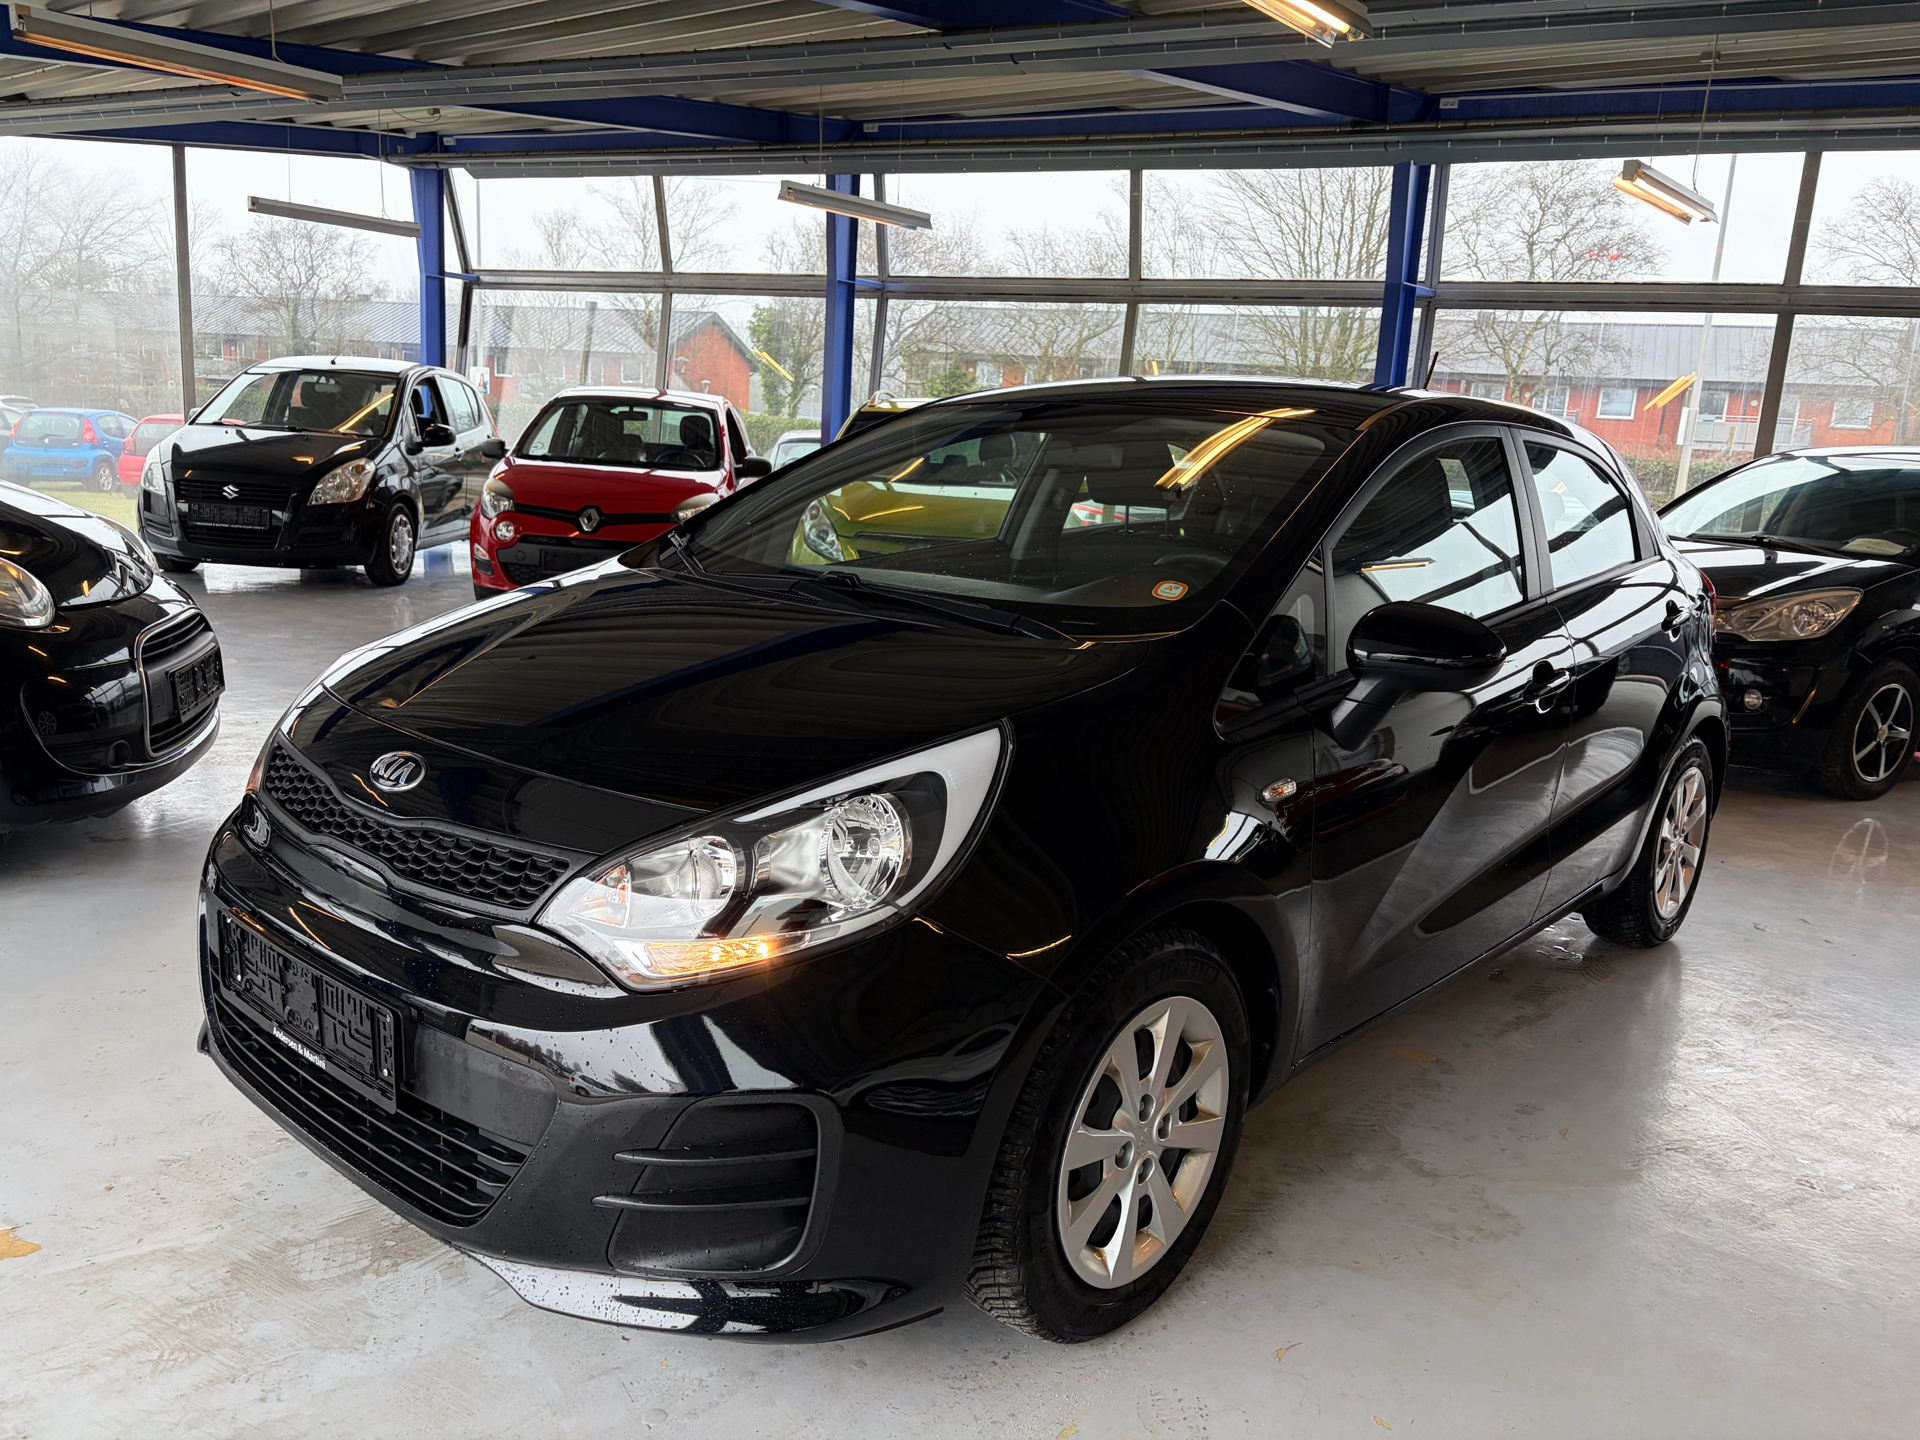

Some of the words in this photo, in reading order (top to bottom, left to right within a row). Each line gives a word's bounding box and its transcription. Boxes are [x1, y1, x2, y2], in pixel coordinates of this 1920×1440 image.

[372, 756, 416, 785] KIA
[1148, 961, 1219, 992] MICHELIN
[273, 1026, 298, 1052] Andersen
[303, 1047, 326, 1070] Martini
